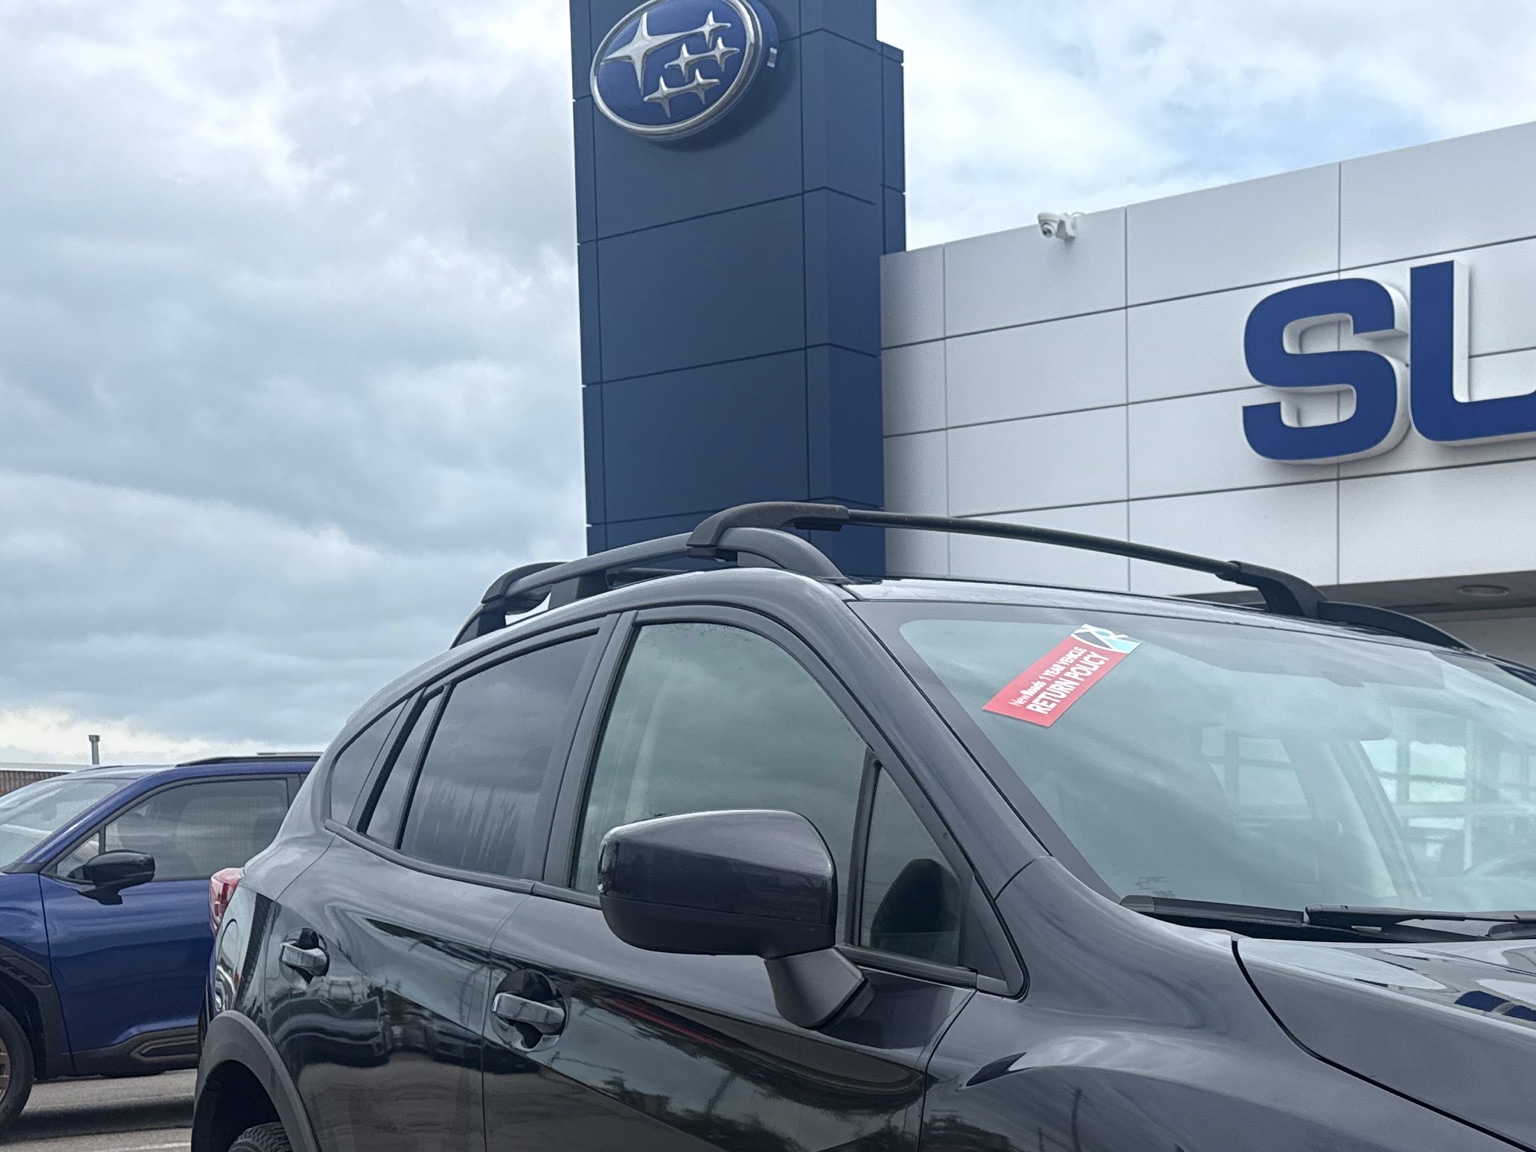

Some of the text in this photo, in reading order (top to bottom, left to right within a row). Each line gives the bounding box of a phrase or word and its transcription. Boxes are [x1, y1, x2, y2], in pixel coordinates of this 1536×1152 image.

[1026, 651, 1110, 714] RETURN POLICY
[1044, 660, 1067, 680] YEAR
[1058, 646, 1087, 668] VEHICLE
